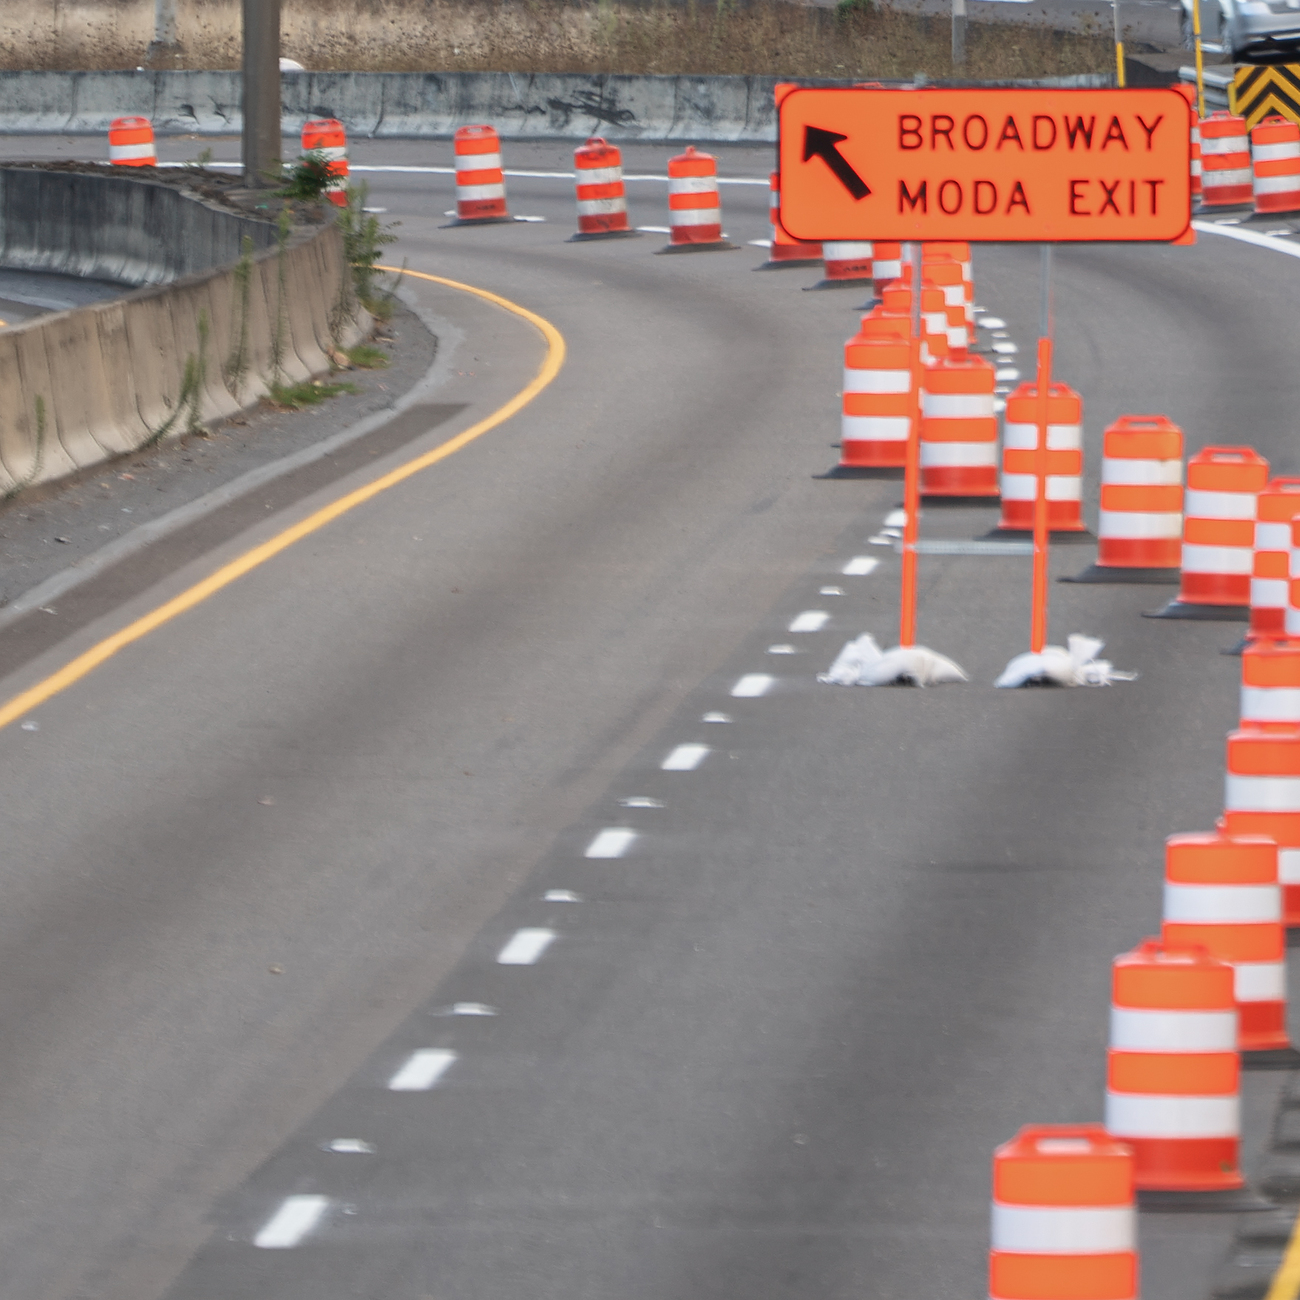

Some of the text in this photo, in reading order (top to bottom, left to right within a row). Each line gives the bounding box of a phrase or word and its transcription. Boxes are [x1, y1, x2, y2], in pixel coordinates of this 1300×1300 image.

[898, 114, 1164, 151] BROADWAY
[898, 179, 1164, 216] MODA EXIT
